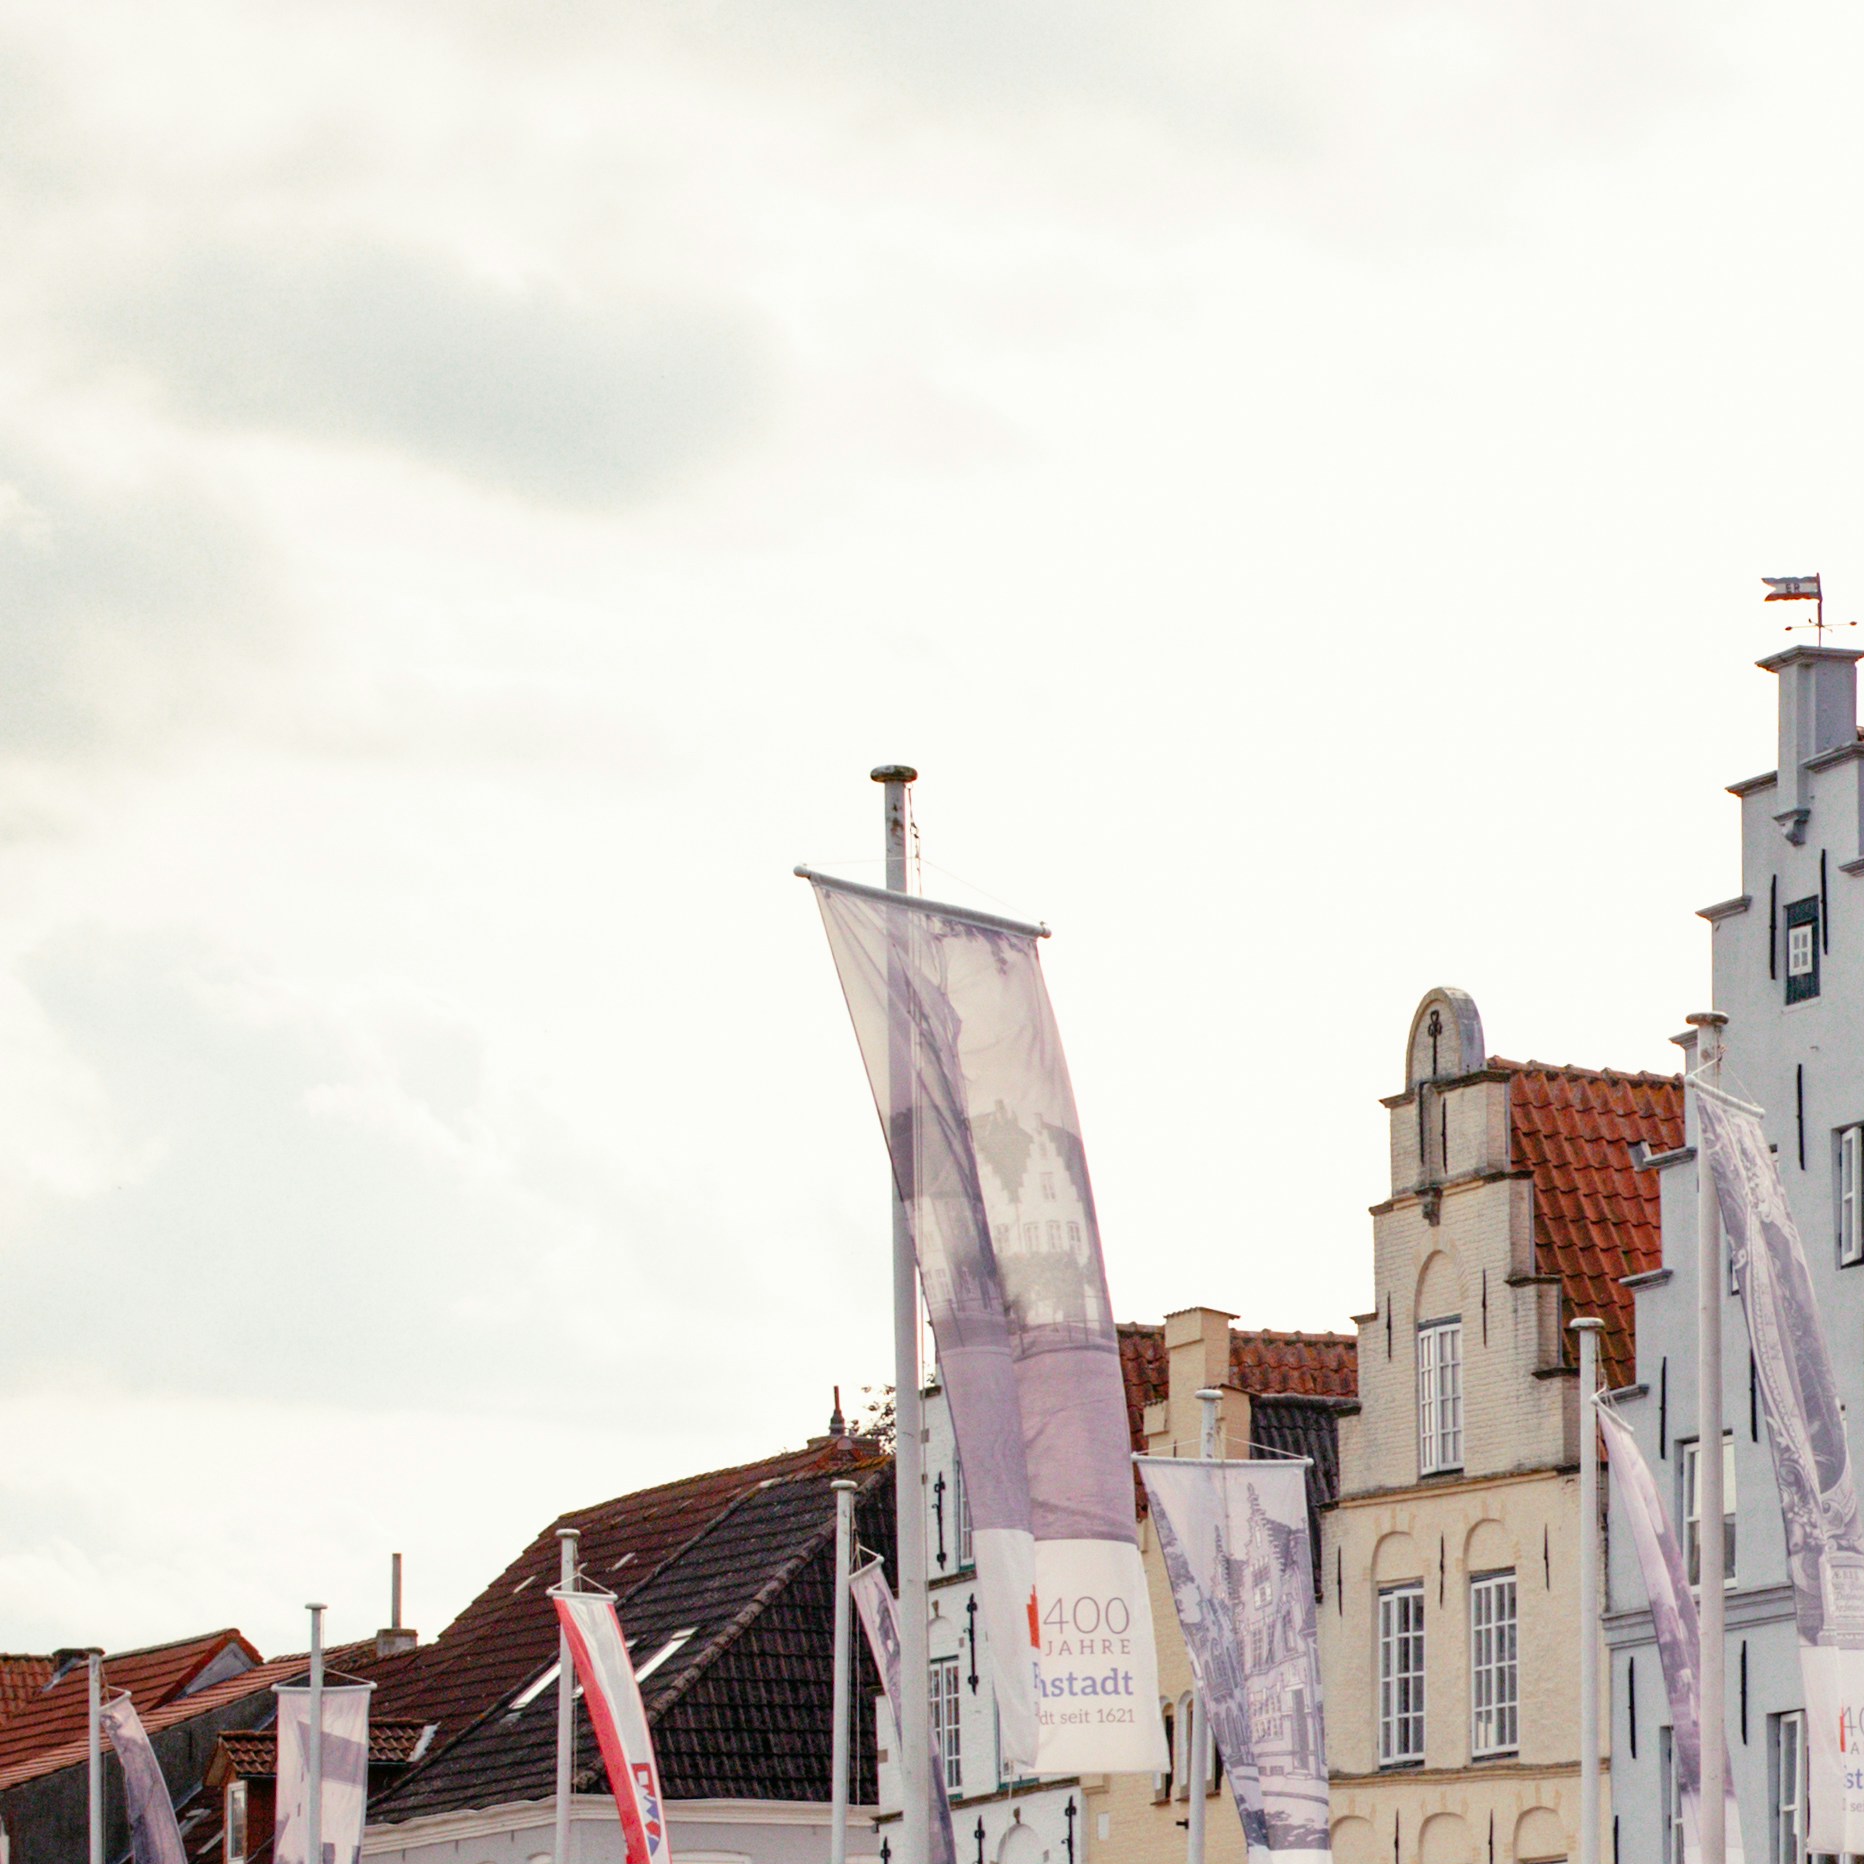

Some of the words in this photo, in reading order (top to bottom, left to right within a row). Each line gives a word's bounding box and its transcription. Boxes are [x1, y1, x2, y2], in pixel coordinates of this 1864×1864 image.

[1042, 1596, 1130, 1635] 400
[1045, 1639, 1131, 1657] JAHRE
[1060, 1709, 1091, 1725] seit
[1097, 1708, 1136, 1724] 1621
